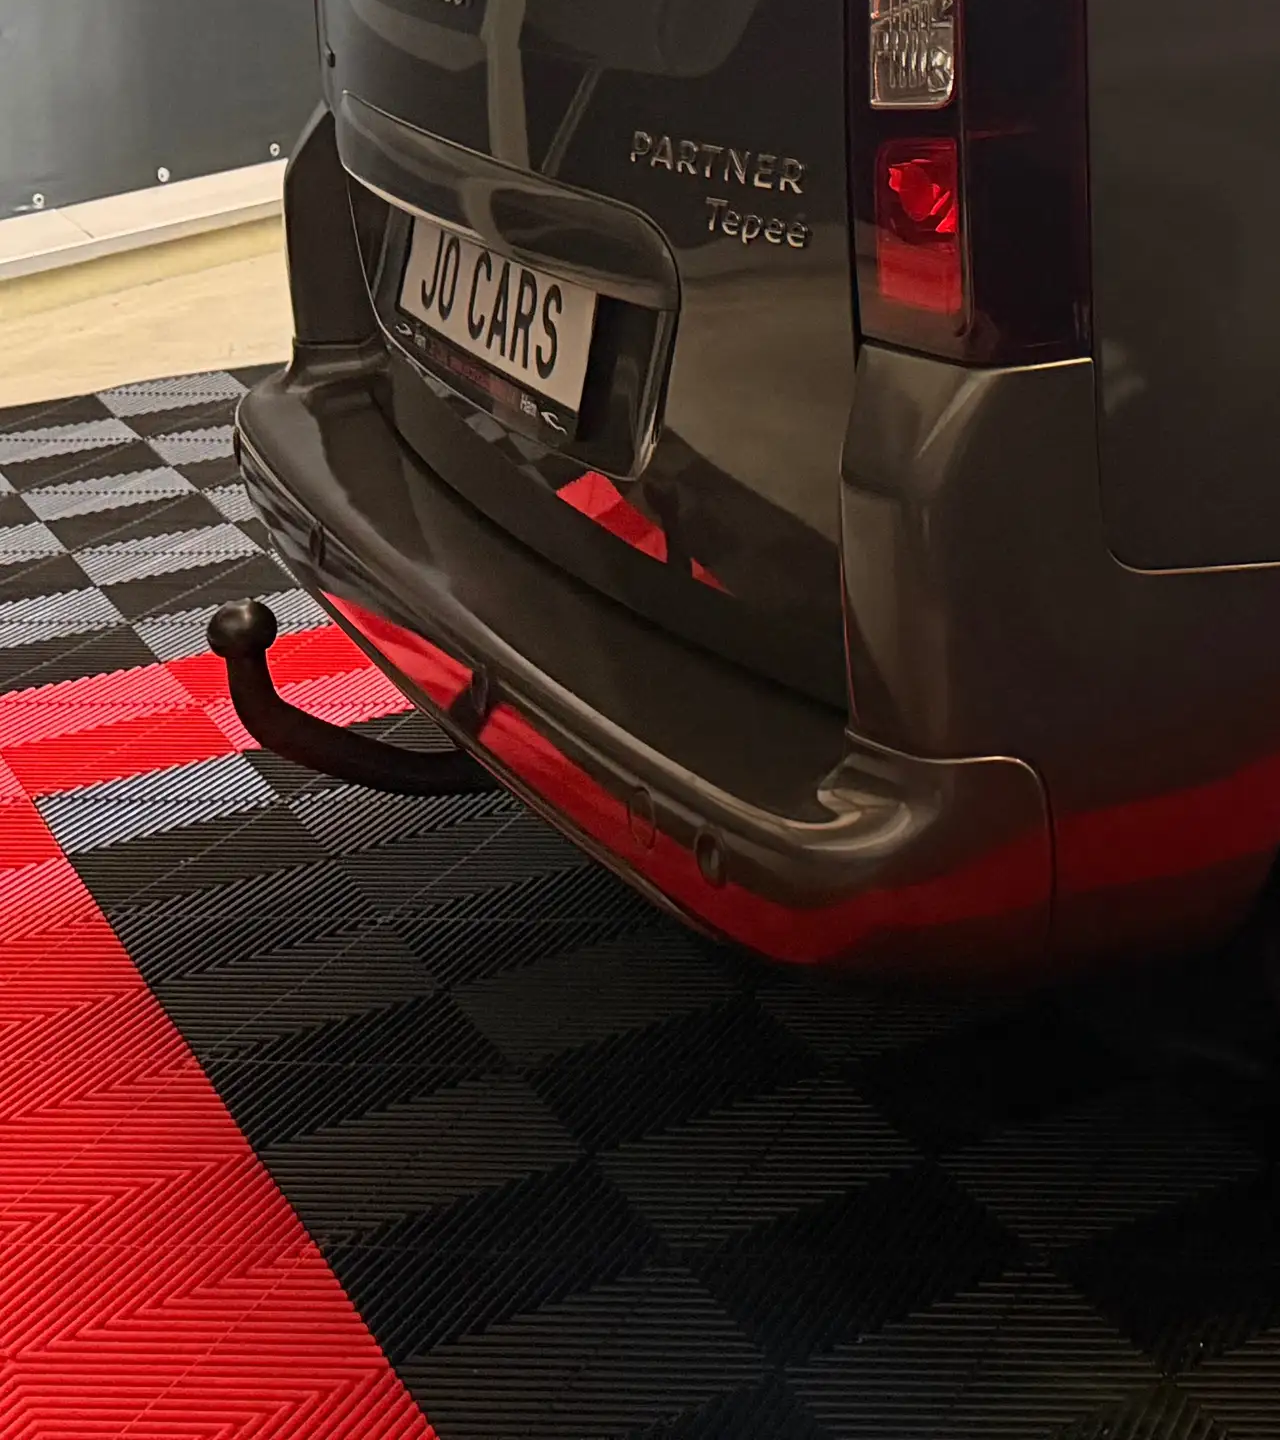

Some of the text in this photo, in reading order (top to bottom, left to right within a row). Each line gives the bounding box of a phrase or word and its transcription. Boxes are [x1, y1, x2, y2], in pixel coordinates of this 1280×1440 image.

[630, 131, 804, 194] PARTNER
[421, 230, 460, 320] JO
[467, 250, 562, 379] CARS
